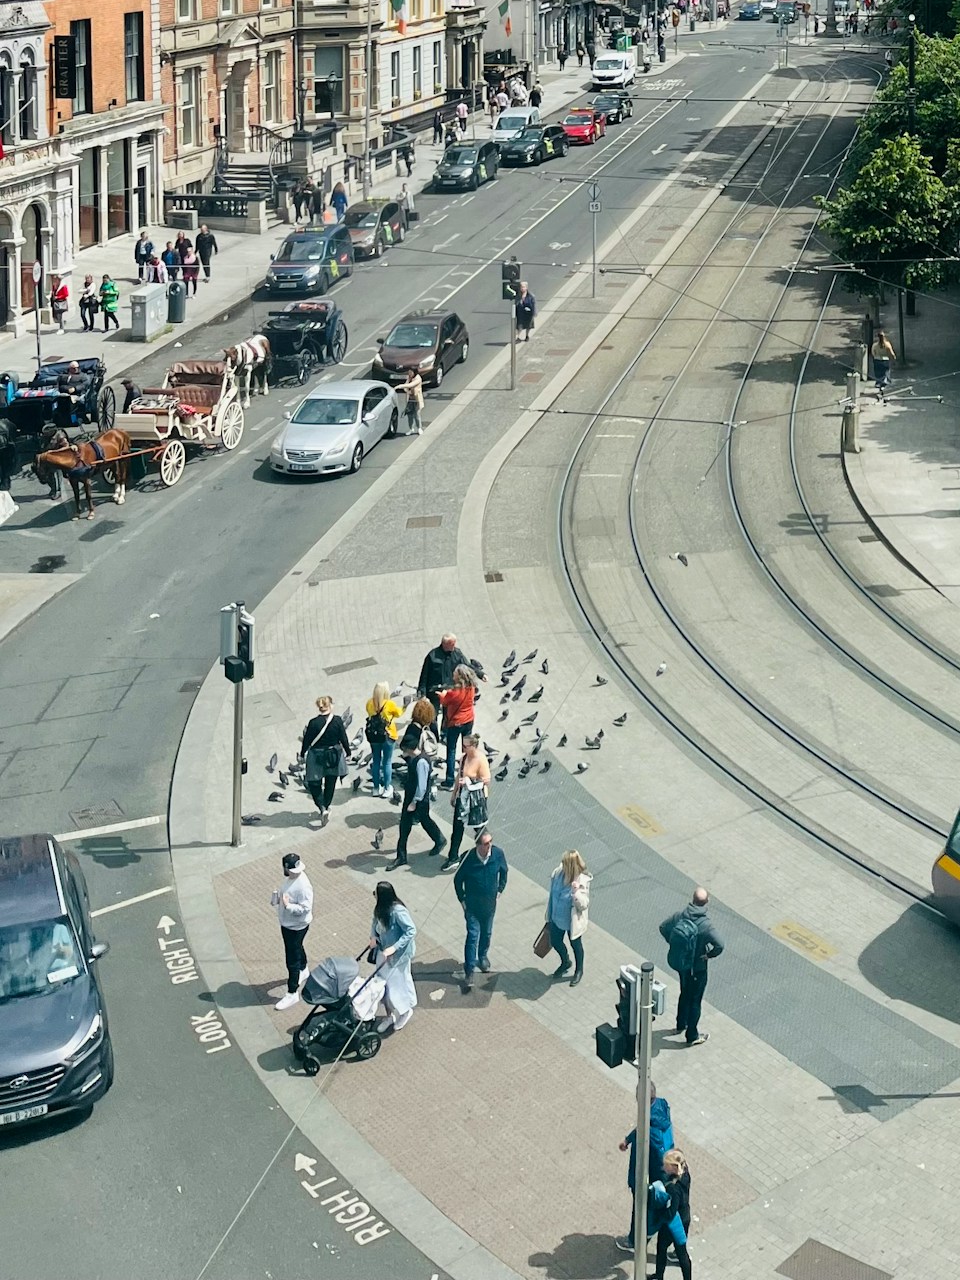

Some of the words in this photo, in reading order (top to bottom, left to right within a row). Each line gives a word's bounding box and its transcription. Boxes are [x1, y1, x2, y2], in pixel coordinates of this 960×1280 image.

[58, 39, 69, 96] GRAFTER
[158, 937, 199, 985] RIGHT
[191, 1010, 231, 1054] LOOK
[301, 1176, 391, 1246] RIGHT
